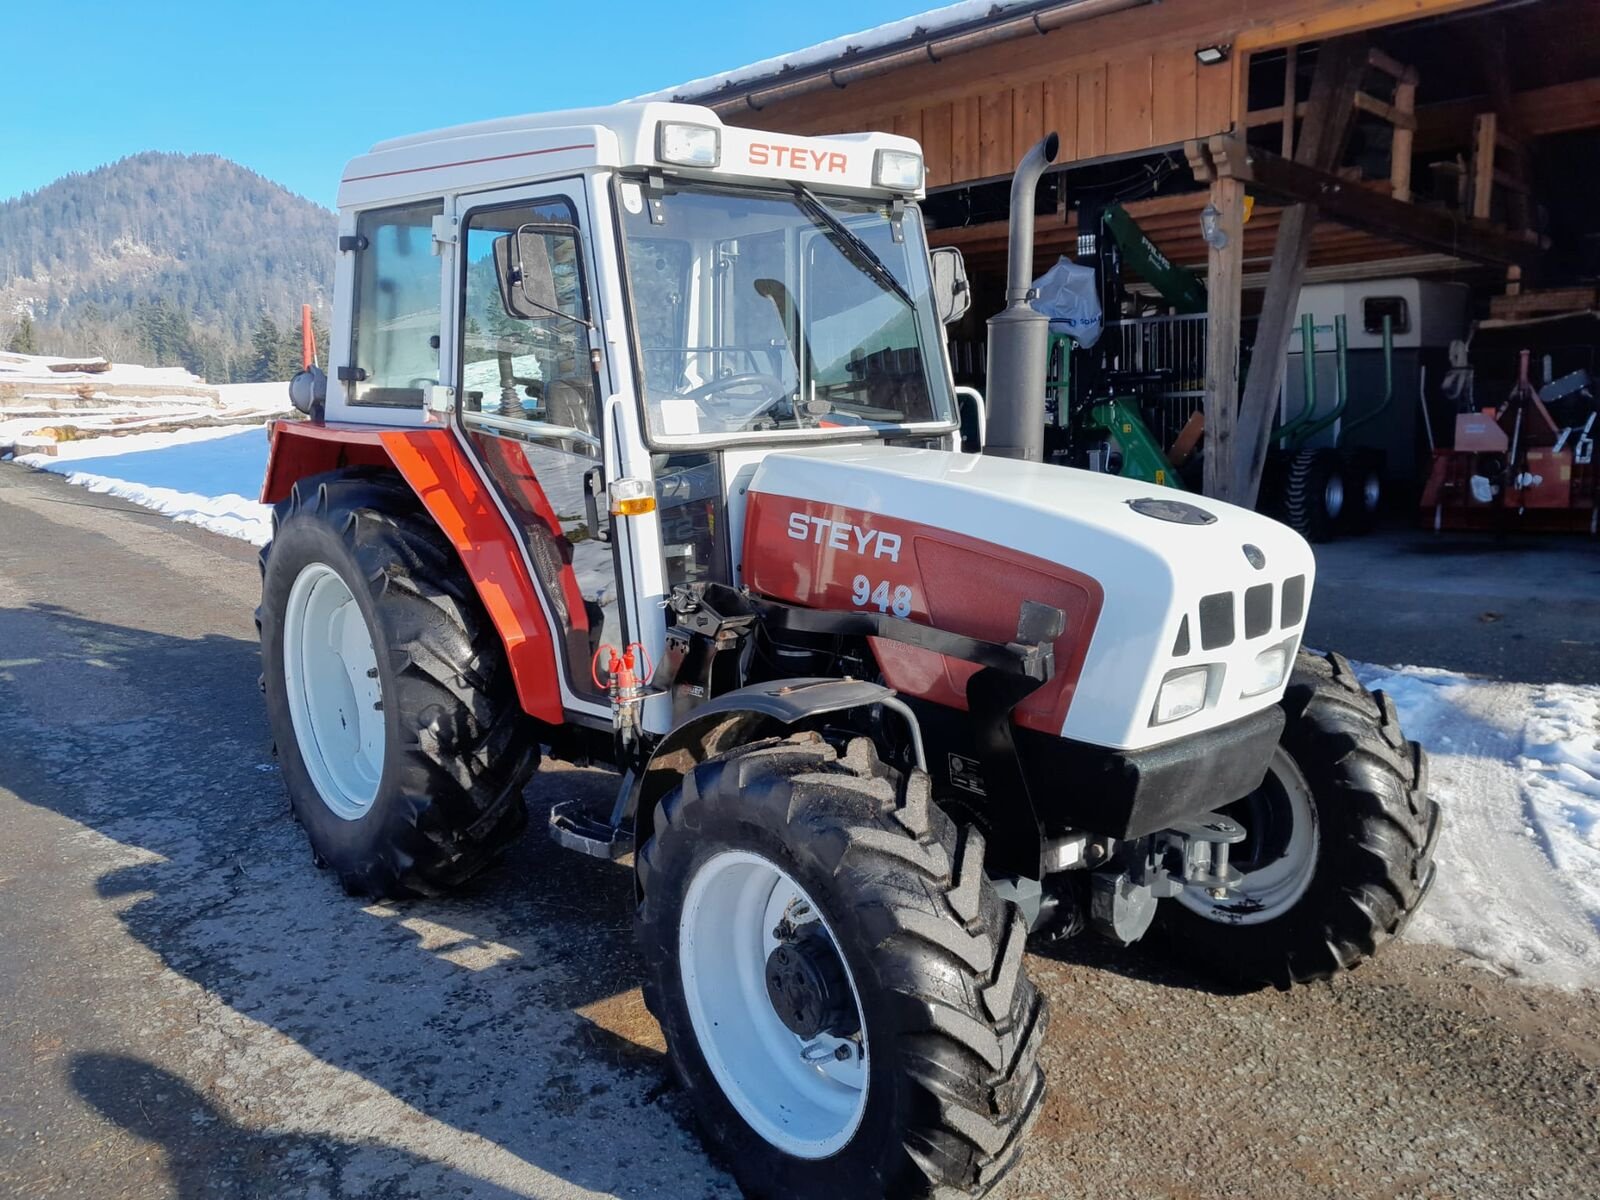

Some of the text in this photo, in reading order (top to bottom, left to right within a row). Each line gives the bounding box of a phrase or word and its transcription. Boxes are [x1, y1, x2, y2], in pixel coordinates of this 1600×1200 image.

[749, 143, 847, 173] STEYR
[788, 512, 901, 562] STEYR
[852, 575, 912, 617] 948
